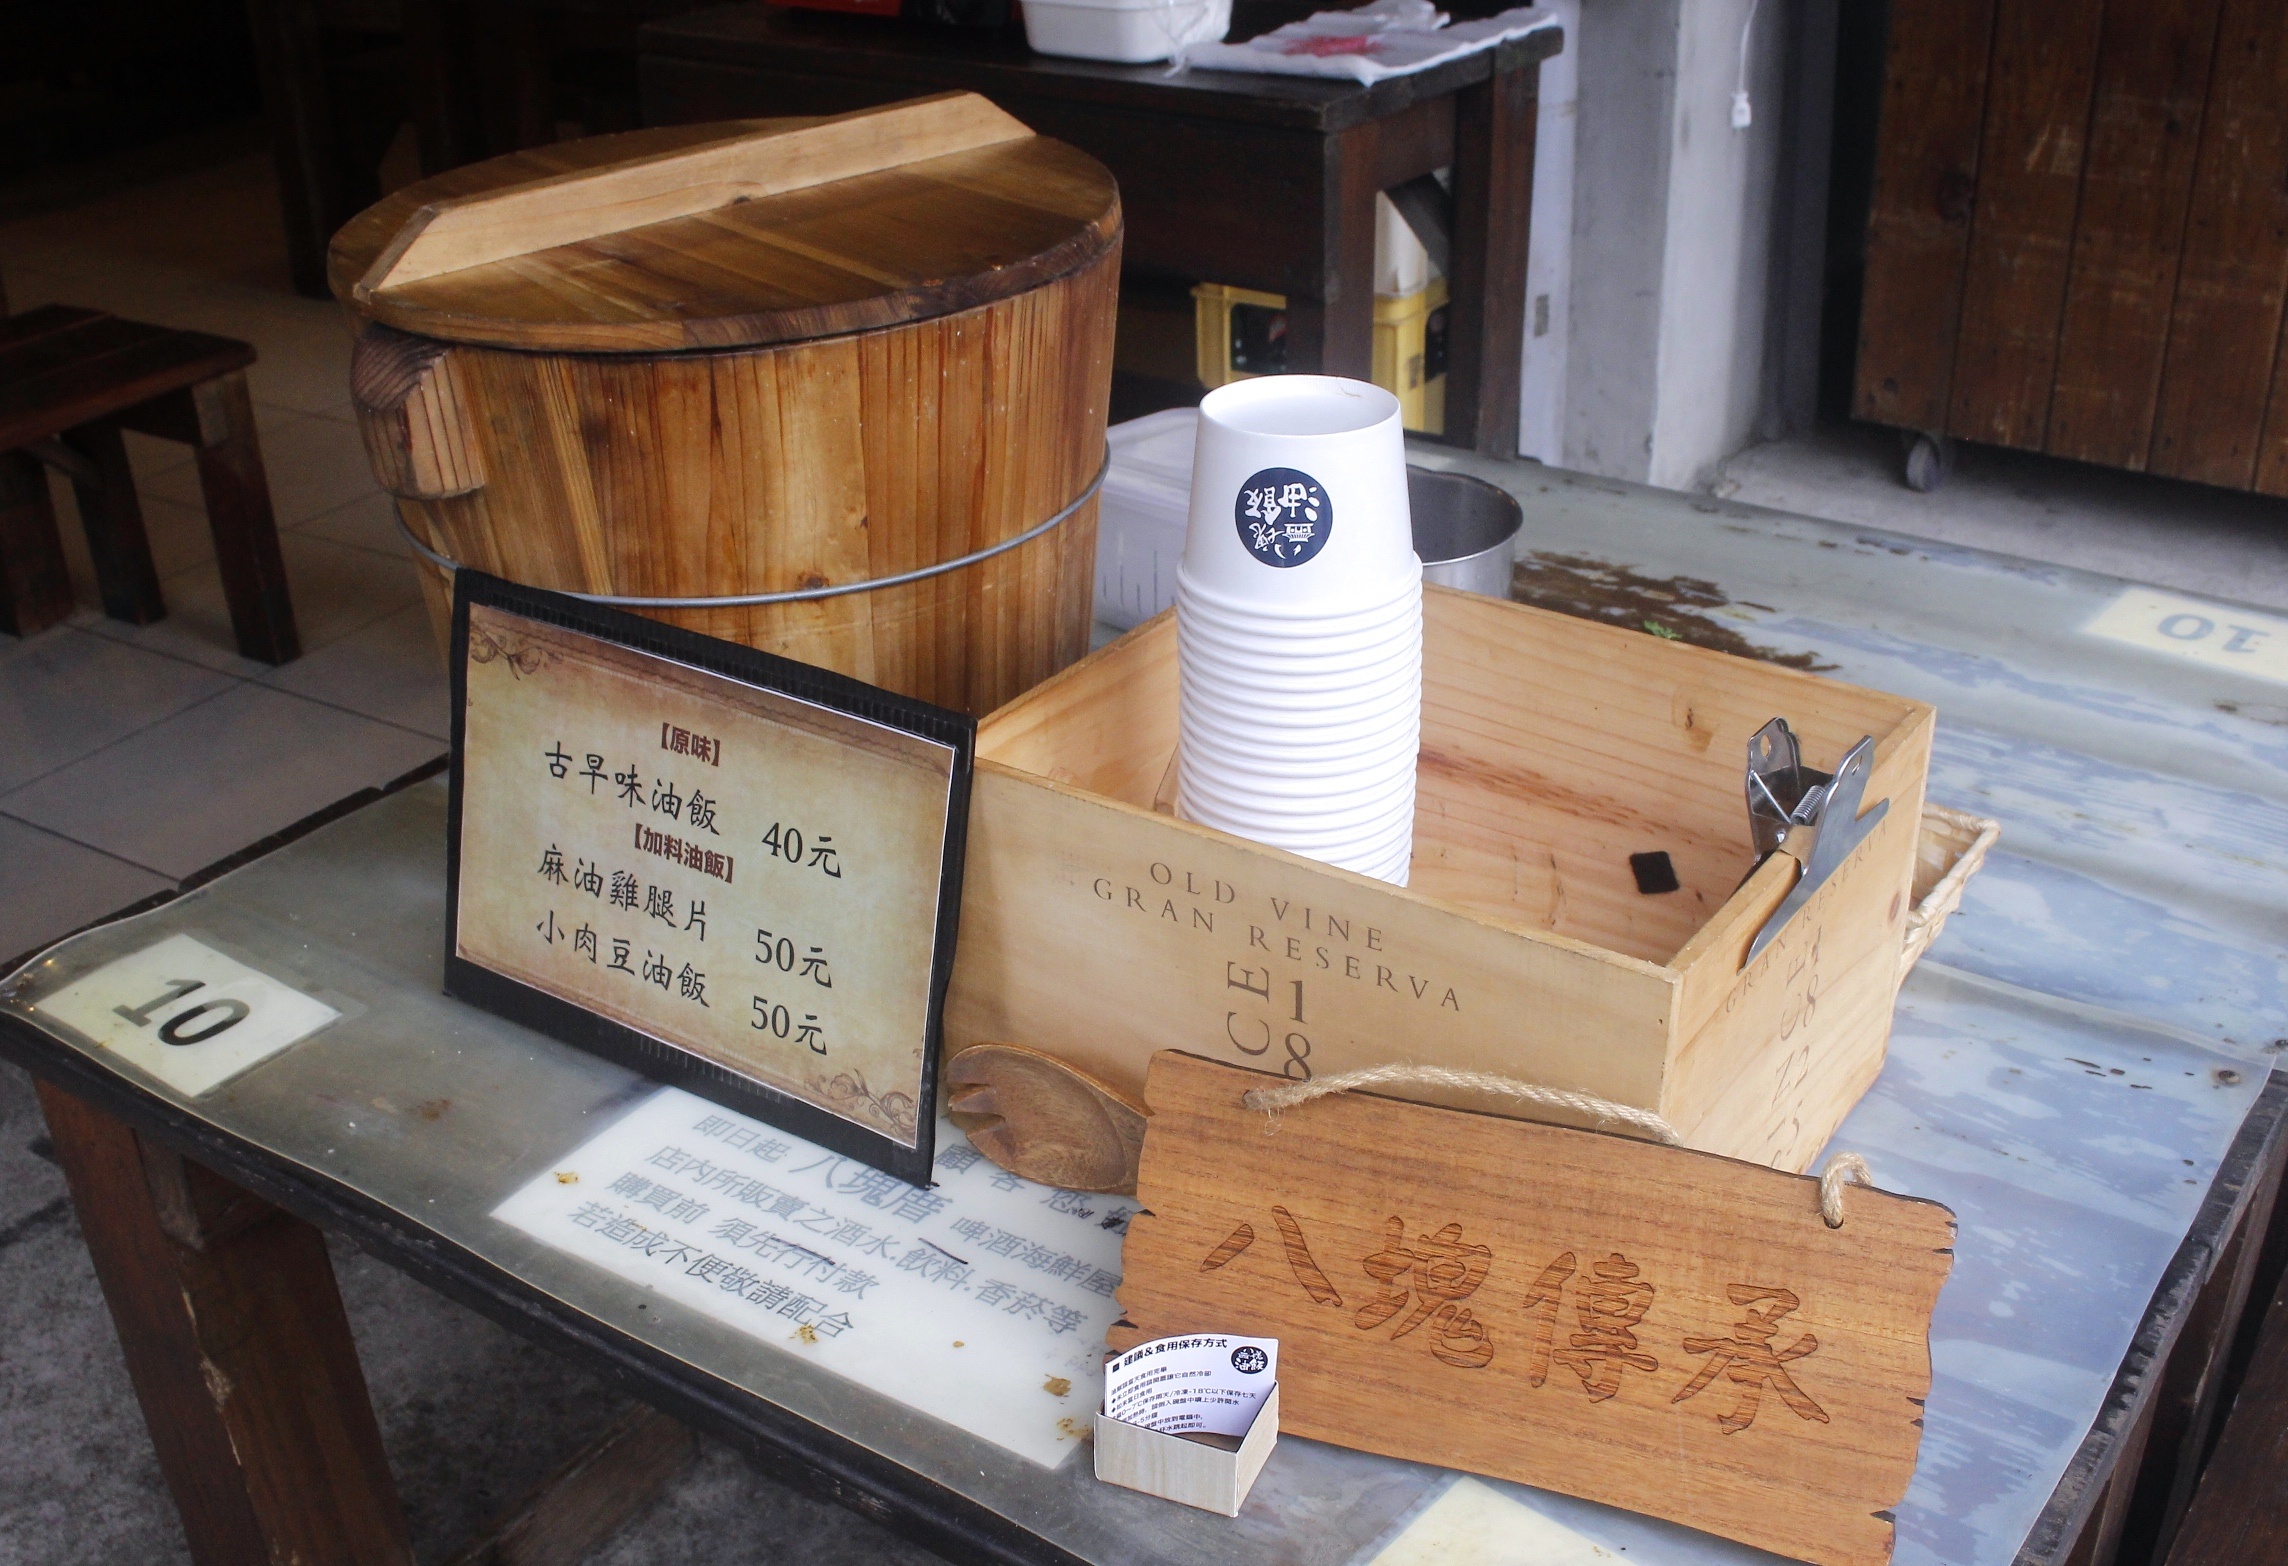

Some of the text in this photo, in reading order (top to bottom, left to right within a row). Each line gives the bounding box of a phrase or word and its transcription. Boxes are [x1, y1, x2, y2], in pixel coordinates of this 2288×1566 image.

[2157, 613, 2271, 652] 10
[544, 741, 842, 879] 古早味油飯 40元
[536, 843, 832, 989] 麻油雞腿片 50元
[1093, 878, 1461, 1011] GRAN RESERVA
[1150, 861, 1383, 952] OLD VINE
[112, 978, 250, 1046] 10
[536, 910, 827, 1056] 小肉豆油飯 50元
[605, 1171, 710, 1225] 購買前
[692, 1114, 791, 1162] 即日起
[950, 1216, 1123, 1298] 啤酒海鮮屋
[567, 1199, 854, 1338] 若造成不便敬請配合
[1201, 1205, 1831, 1435] 八塊傳承
